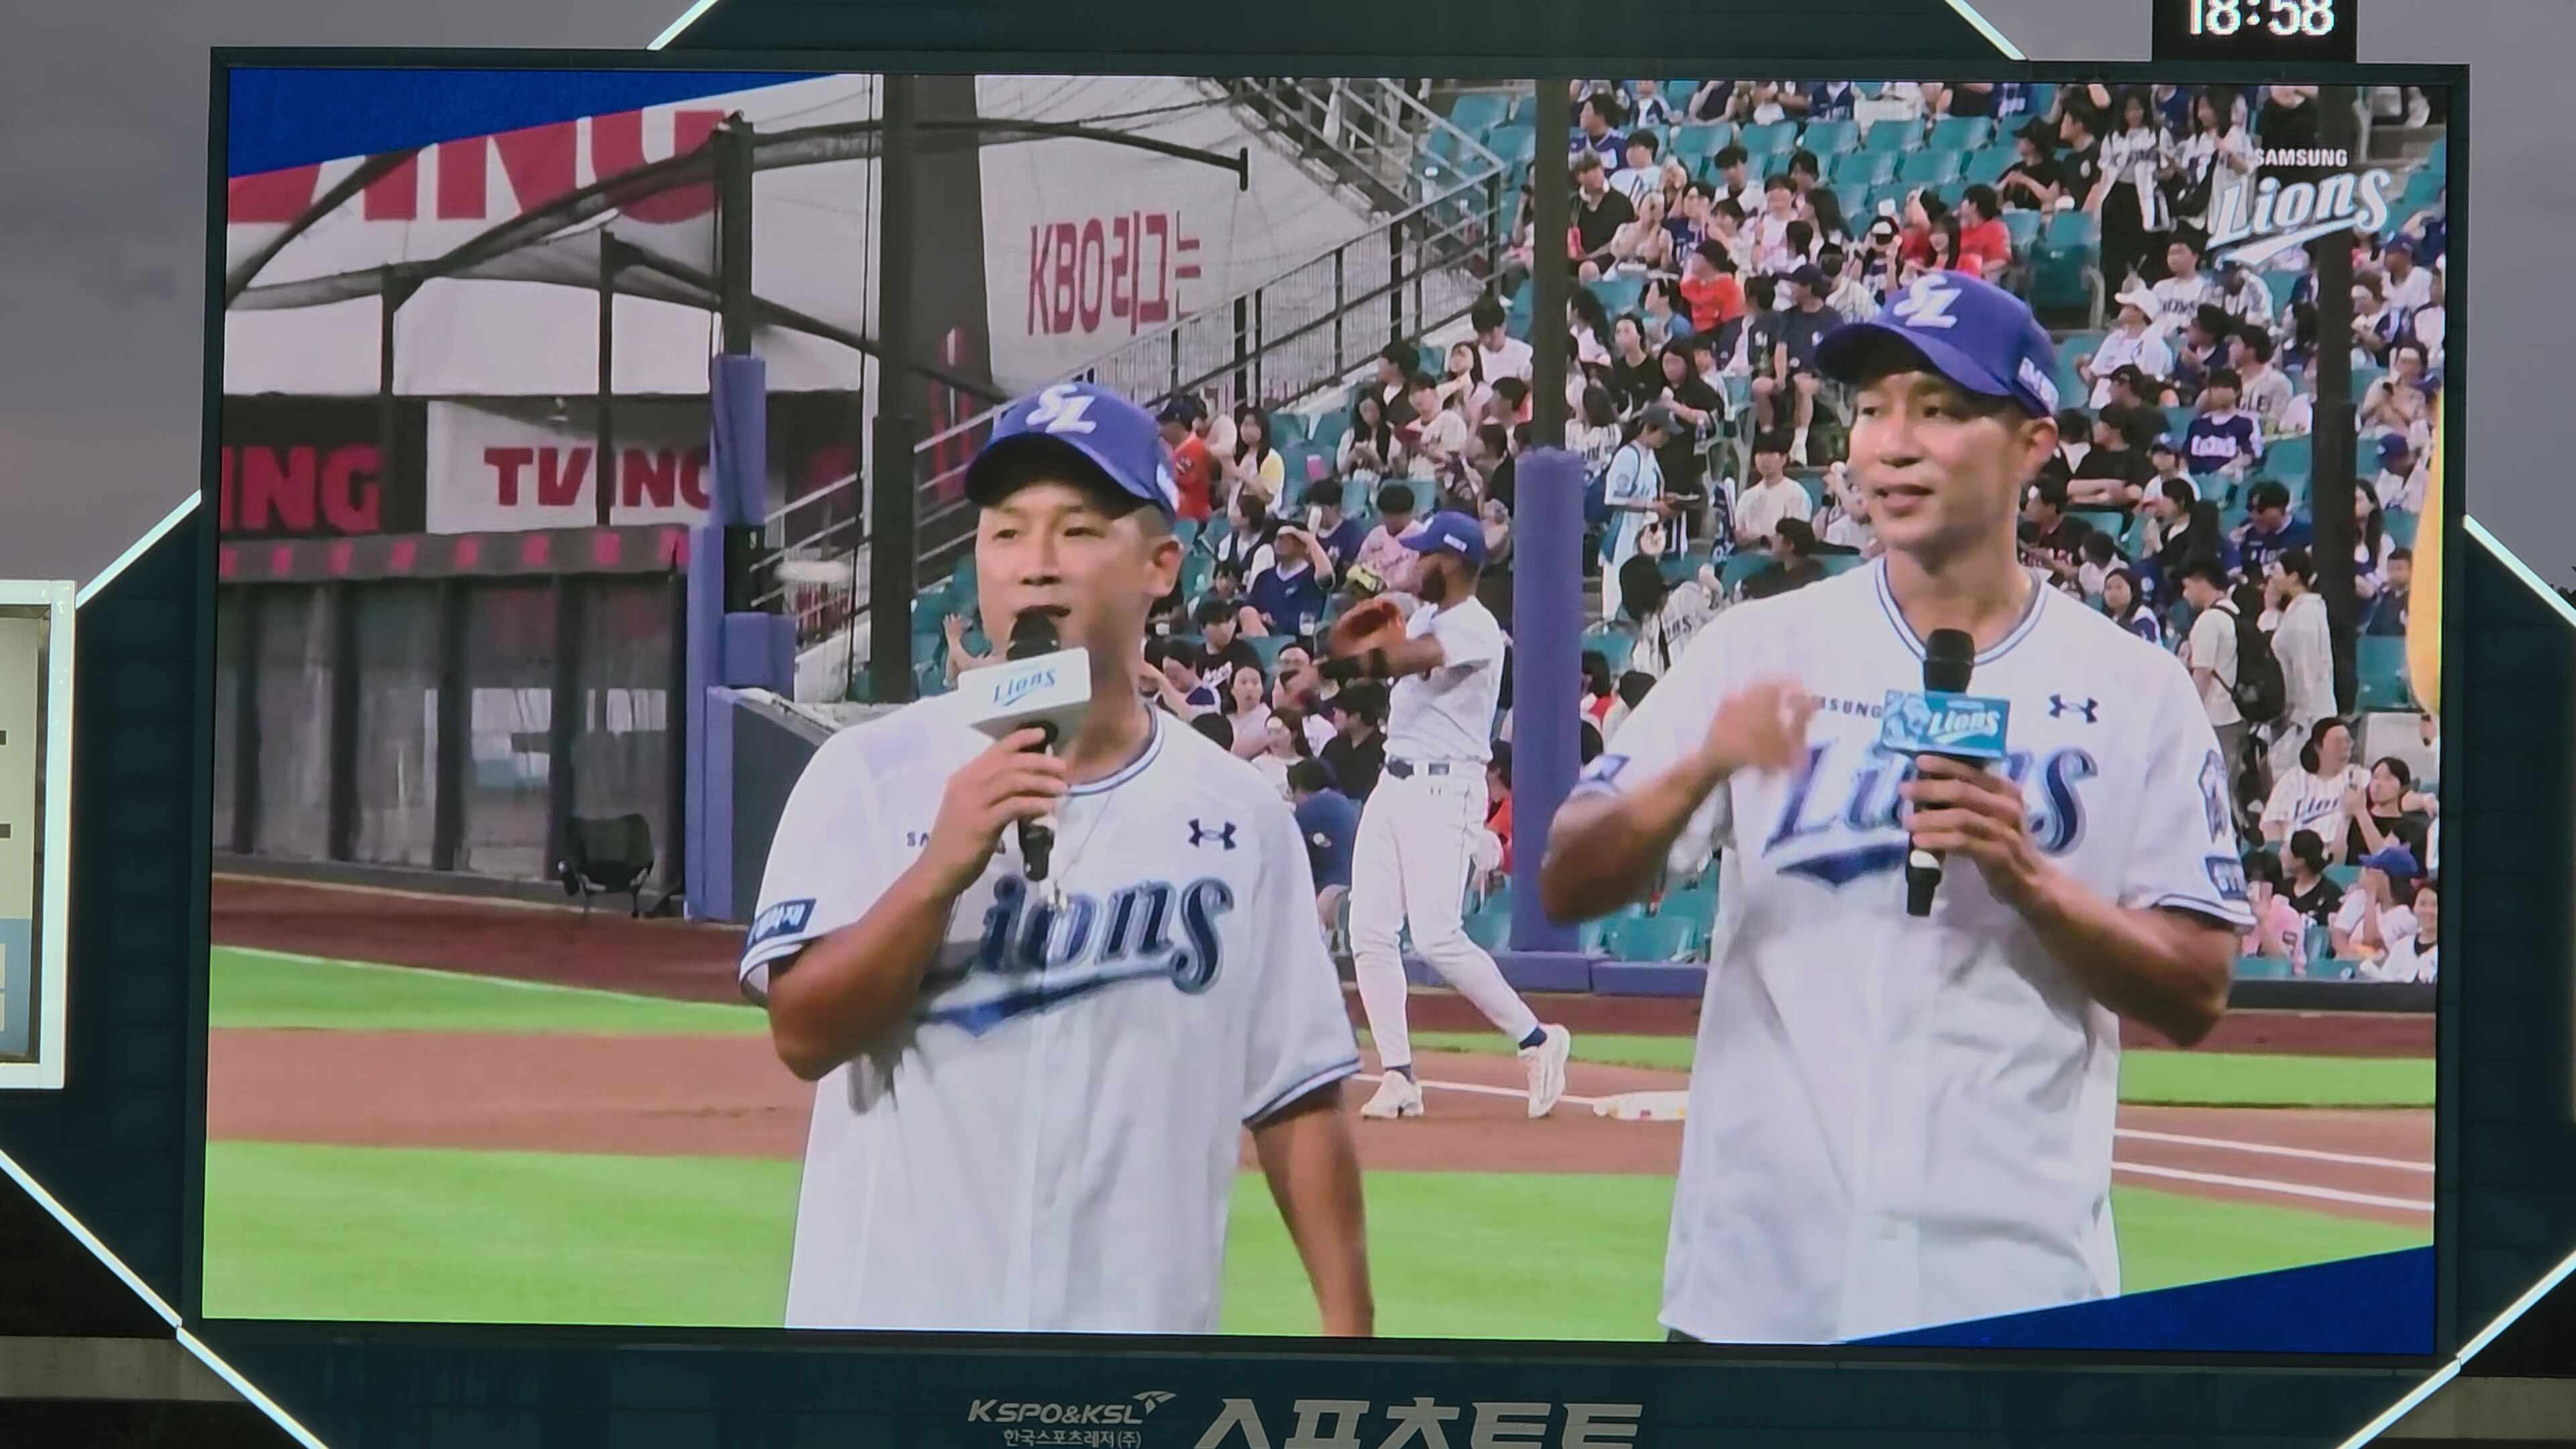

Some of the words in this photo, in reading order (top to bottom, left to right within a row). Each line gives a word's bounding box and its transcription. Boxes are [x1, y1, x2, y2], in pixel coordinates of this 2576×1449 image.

[2190, 0, 2334, 36] 18:58
[2254, 148, 2349, 167] SAMSUNG
[2206, 168, 2393, 252] Lions
[484, 446, 710, 510] TVNG
[973, 872, 1235, 996] ions
[968, 1399, 1143, 1424] KSPO&KSL
